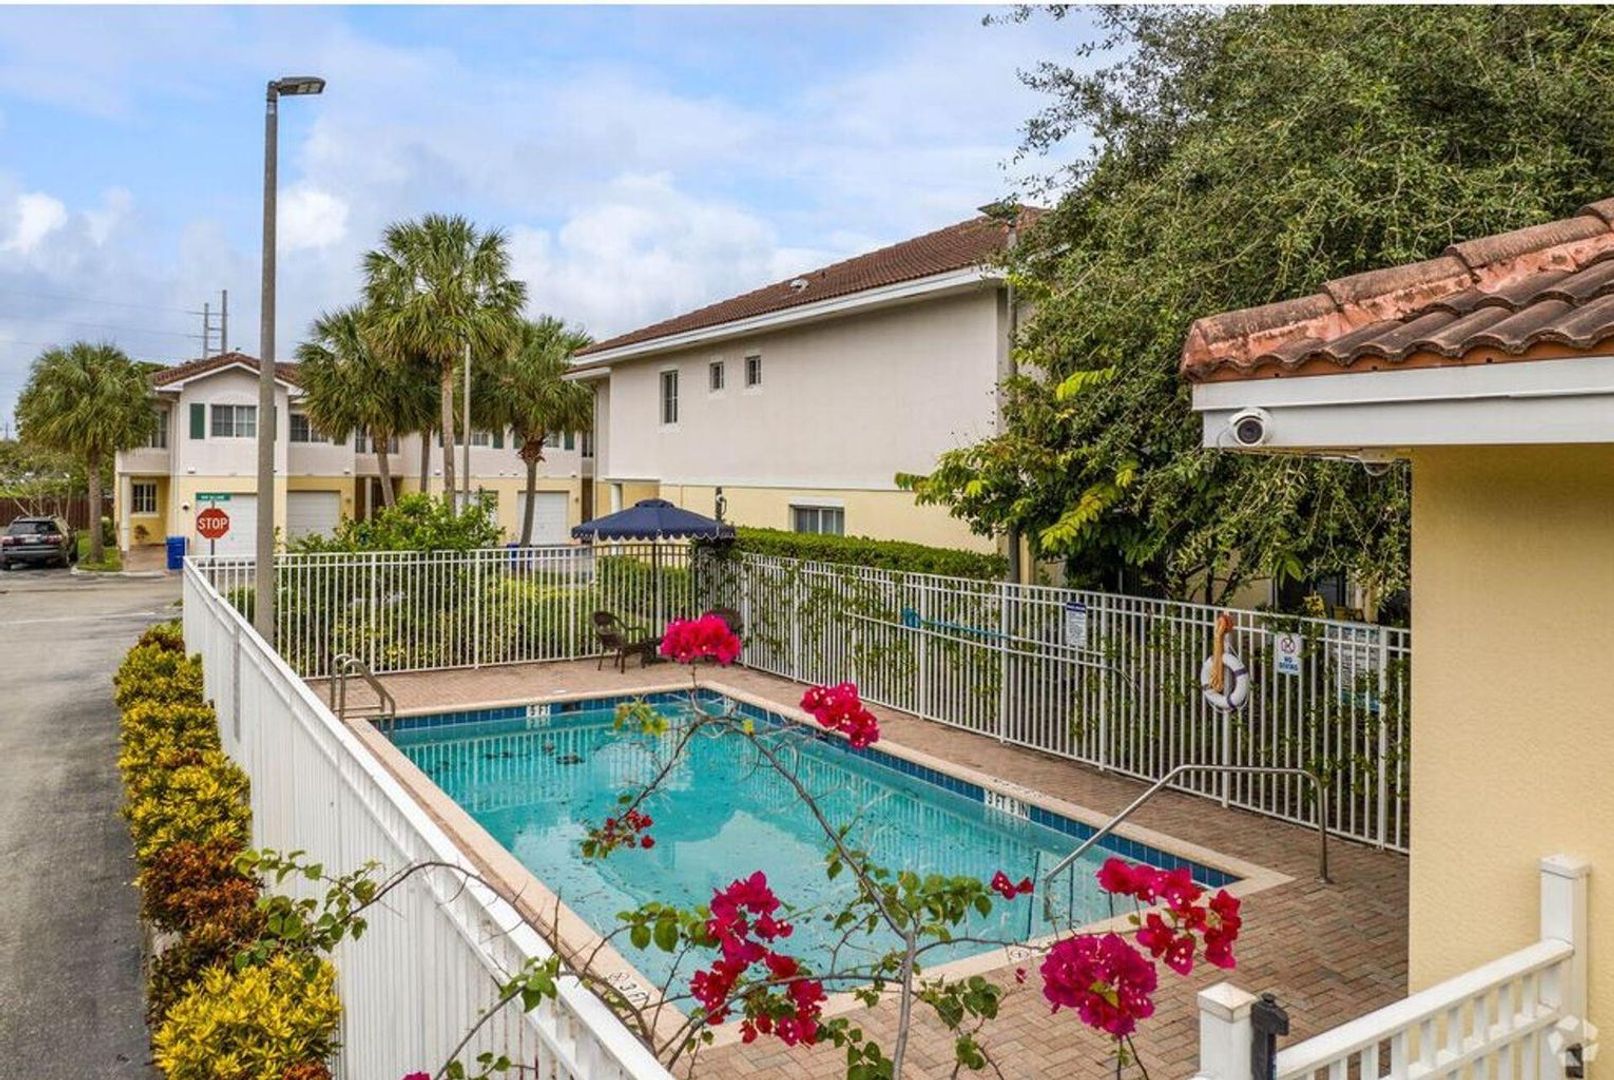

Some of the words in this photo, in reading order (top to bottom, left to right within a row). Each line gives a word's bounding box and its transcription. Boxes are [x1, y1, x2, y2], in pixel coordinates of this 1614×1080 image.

[198, 517, 228, 530] STOP
[1279, 662, 1299, 671] DIVING
[988, 790, 993, 804] 3
[995, 793, 1006, 809] FT
[1018, 802, 1028, 817] IN
